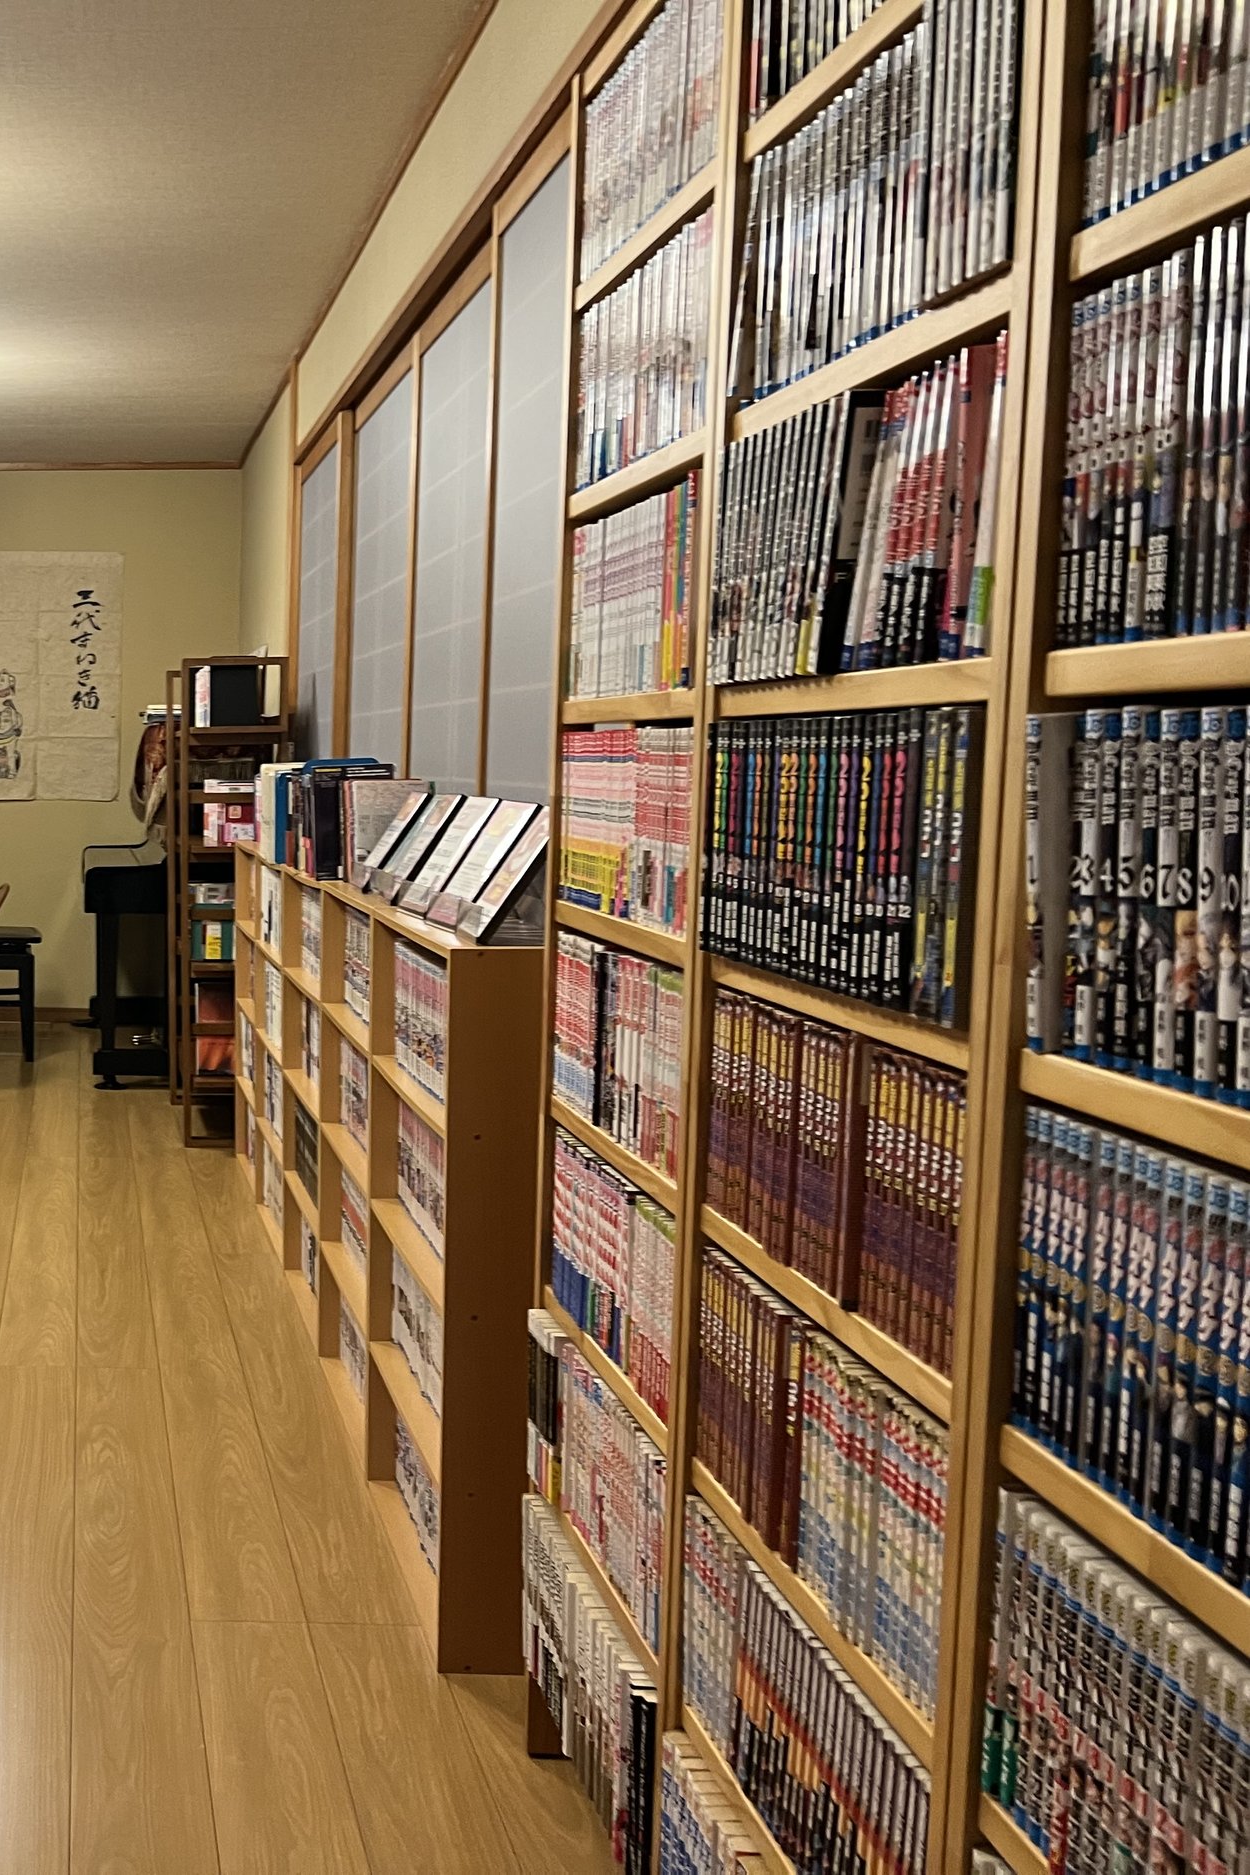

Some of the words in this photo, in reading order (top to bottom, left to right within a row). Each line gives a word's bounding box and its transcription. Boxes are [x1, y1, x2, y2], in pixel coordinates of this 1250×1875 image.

[1100, 859, 1114, 892] 4
[1118, 857, 1134, 888] 5
[1140, 865, 1154, 898] 6
[1159, 864, 1174, 899] 7
[1176, 868, 1193, 905] 8
[1198, 866, 1215, 902] 9
